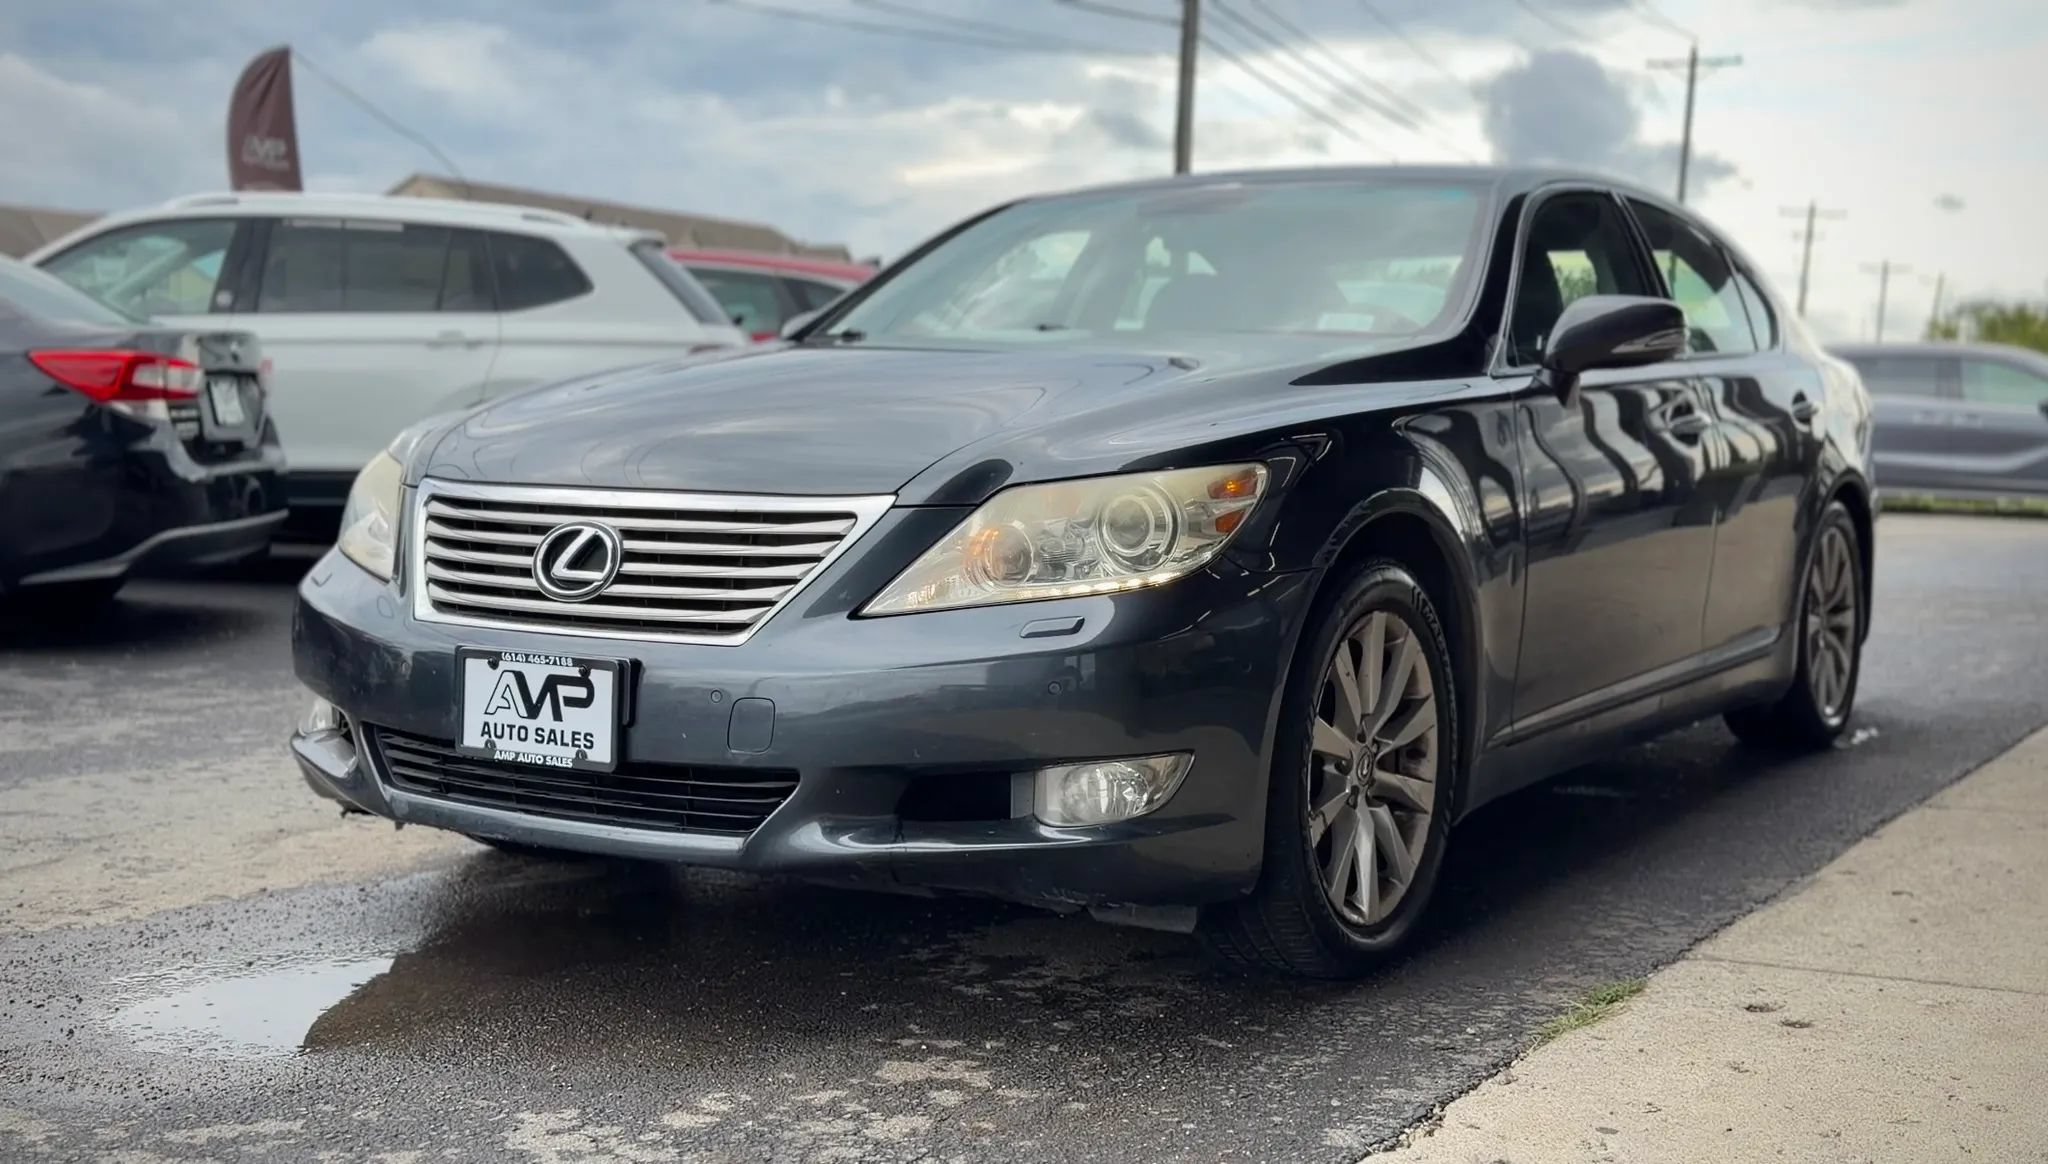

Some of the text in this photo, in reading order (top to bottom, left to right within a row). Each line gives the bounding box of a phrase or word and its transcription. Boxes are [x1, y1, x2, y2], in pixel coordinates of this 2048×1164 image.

[501, 652, 573, 667] (614) 465-7188
[484, 669, 595, 722] AMP
[480, 721, 594, 750] AUTO SALES
[494, 750, 573, 768] AMP AUTO SALES
